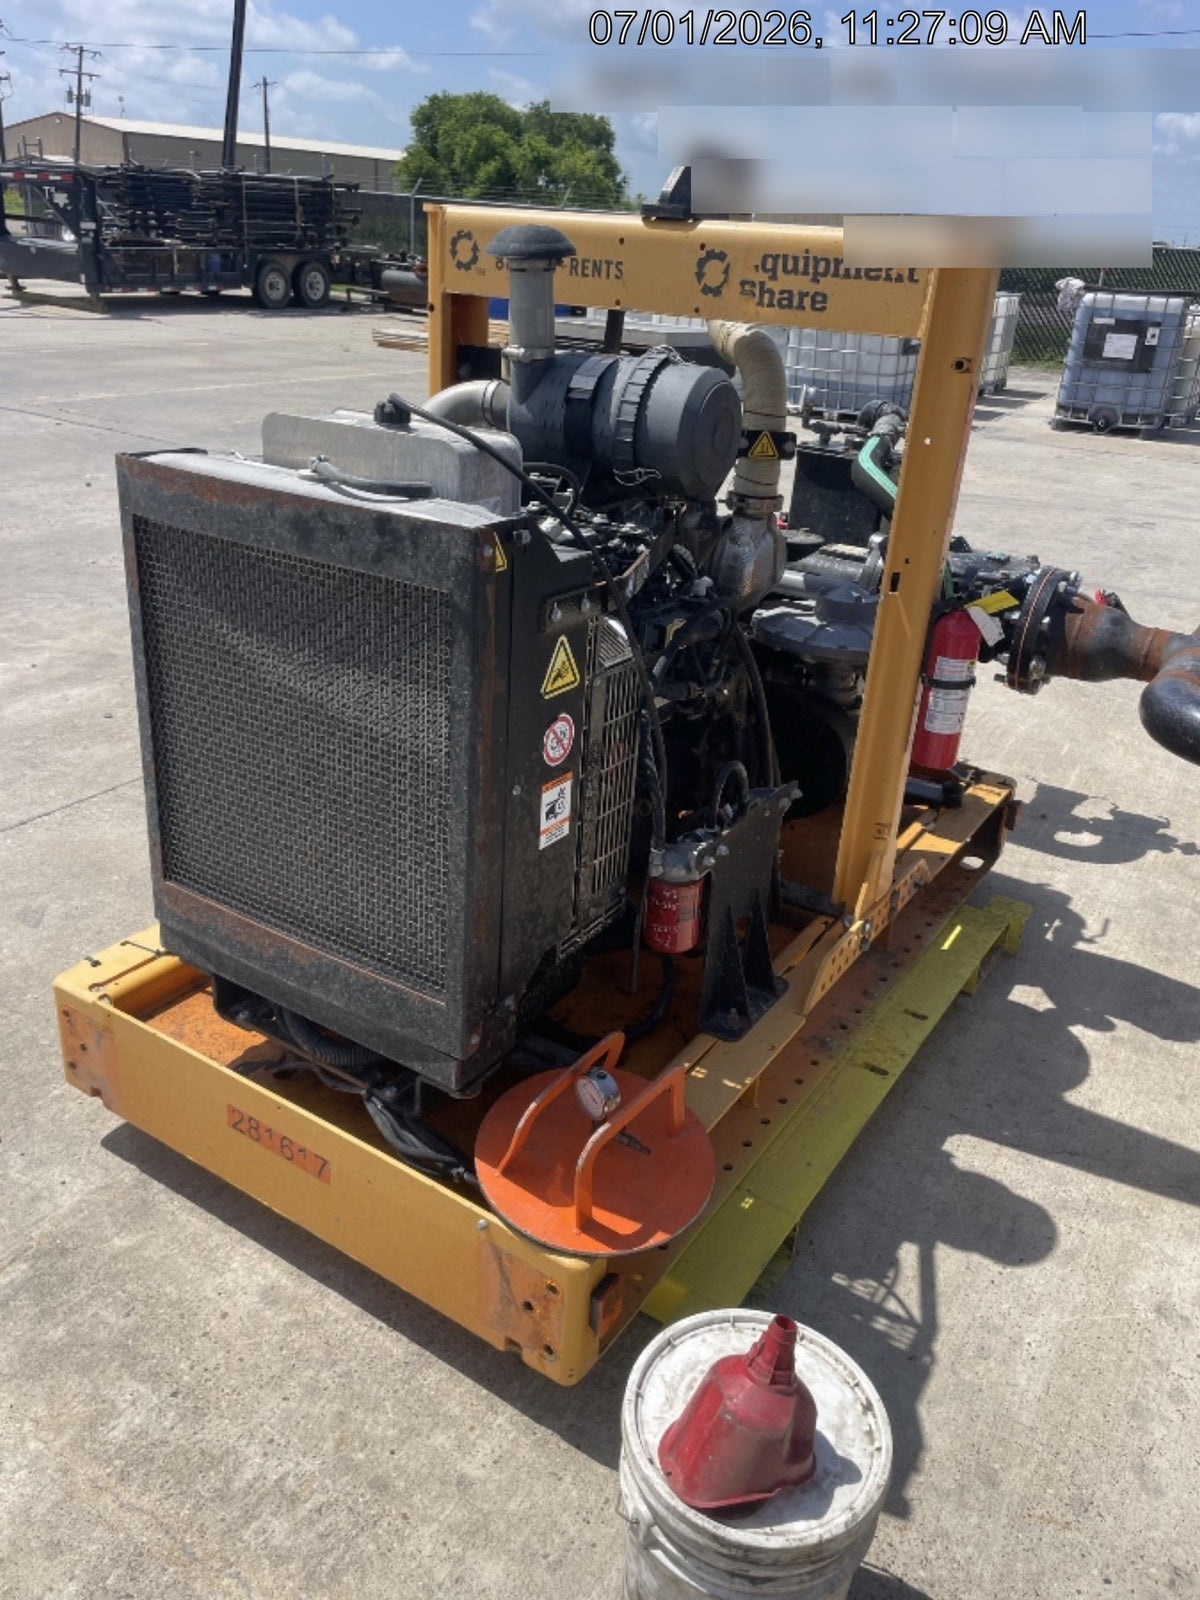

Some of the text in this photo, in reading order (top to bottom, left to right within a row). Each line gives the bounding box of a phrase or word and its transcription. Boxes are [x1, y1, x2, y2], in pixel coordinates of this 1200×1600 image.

[569, 257, 623, 279] RENTS
[754, 248, 920, 284] quipment
[231, 1107, 329, 1178] 281617
